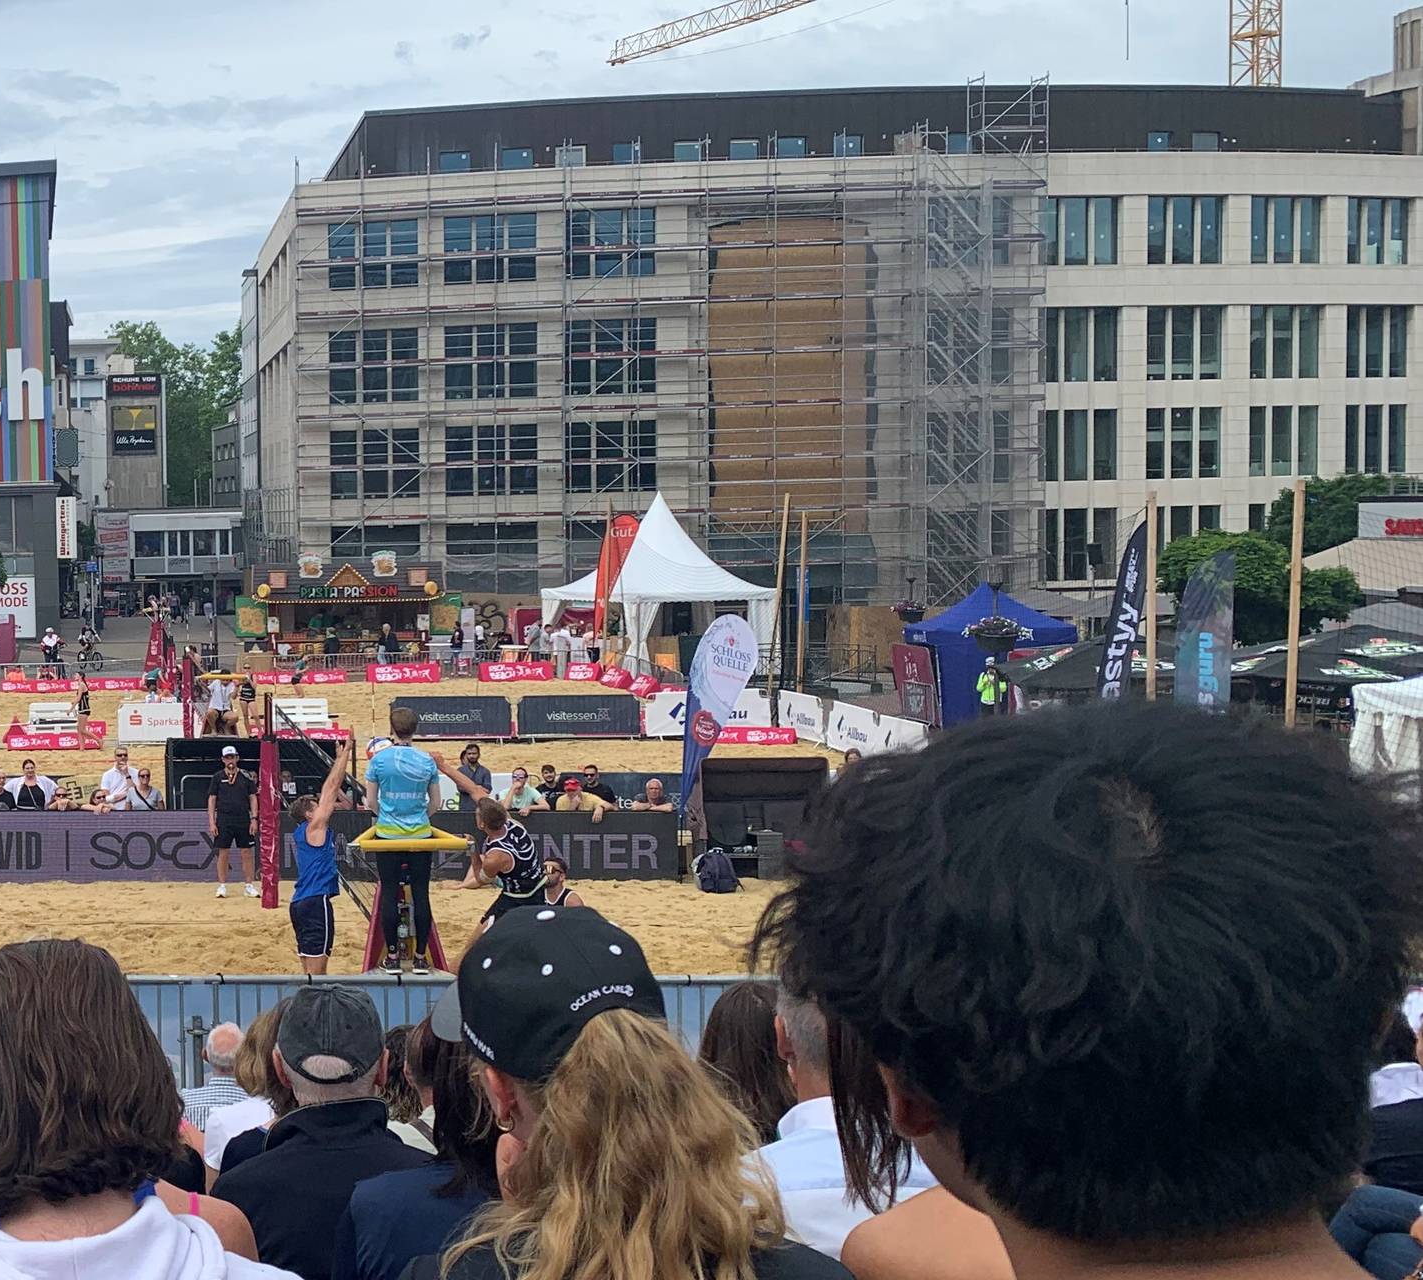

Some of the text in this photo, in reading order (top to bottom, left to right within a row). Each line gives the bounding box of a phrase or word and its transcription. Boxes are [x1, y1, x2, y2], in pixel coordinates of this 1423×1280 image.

[113, 383, 155, 391] böhmer
[300, 585, 398, 598] PASTA PASSION
[711, 643, 751, 663] SCHLOSS
[1101, 600, 1139, 699] astyy
[713, 654, 748, 672] QUELLE
[1198, 632, 1219, 705] sguru
[419, 710, 469, 722] visitessen
[546, 709, 597, 721] visitessen
[847, 727, 868, 743] Allbau
[570, 989, 601, 1011] OCEAN
